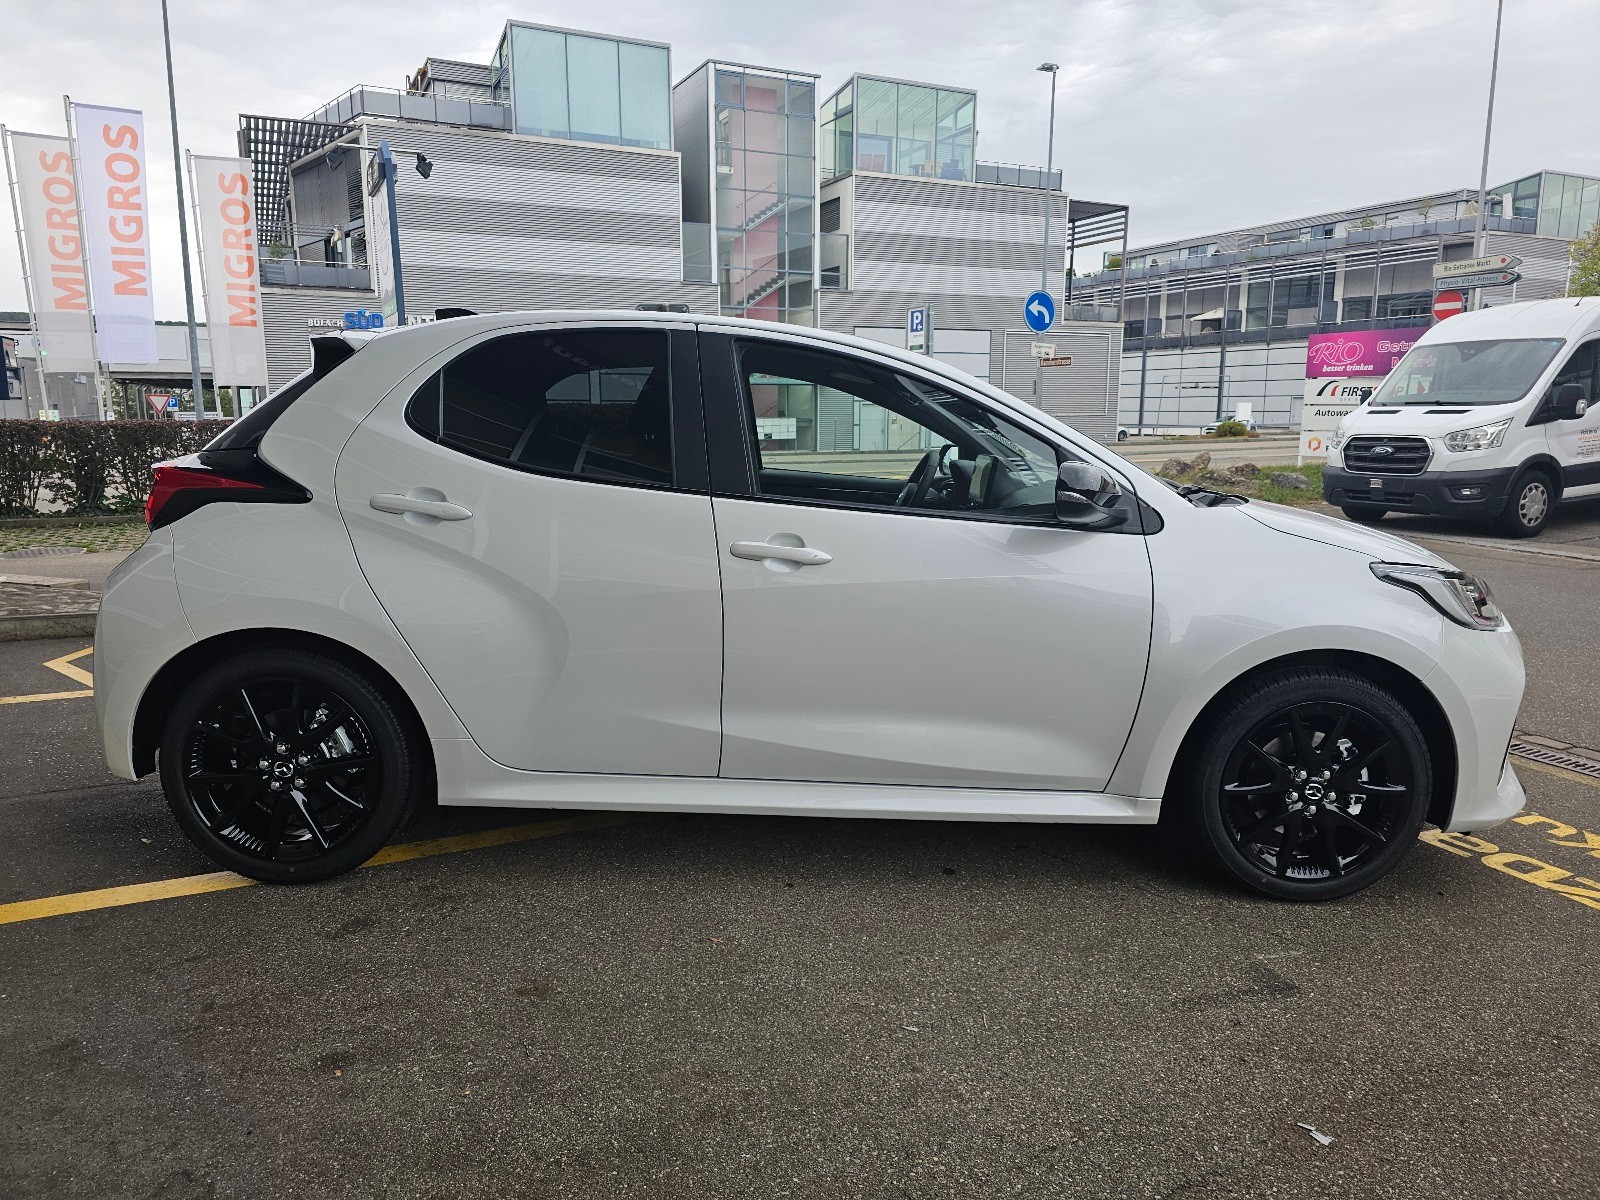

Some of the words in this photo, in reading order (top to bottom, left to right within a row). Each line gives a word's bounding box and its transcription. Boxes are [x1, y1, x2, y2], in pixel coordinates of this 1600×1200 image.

[103, 123, 148, 297] MIGROS
[39, 149, 88, 311] MIGROS
[218, 172, 258, 328] MIGROS
[1476, 259, 1491, 267] Markt
[344, 308, 384, 330] SÜD
[913, 311, 922, 330] P
[1322, 364, 1345, 373] besser
[1346, 363, 1374, 372] trinken
